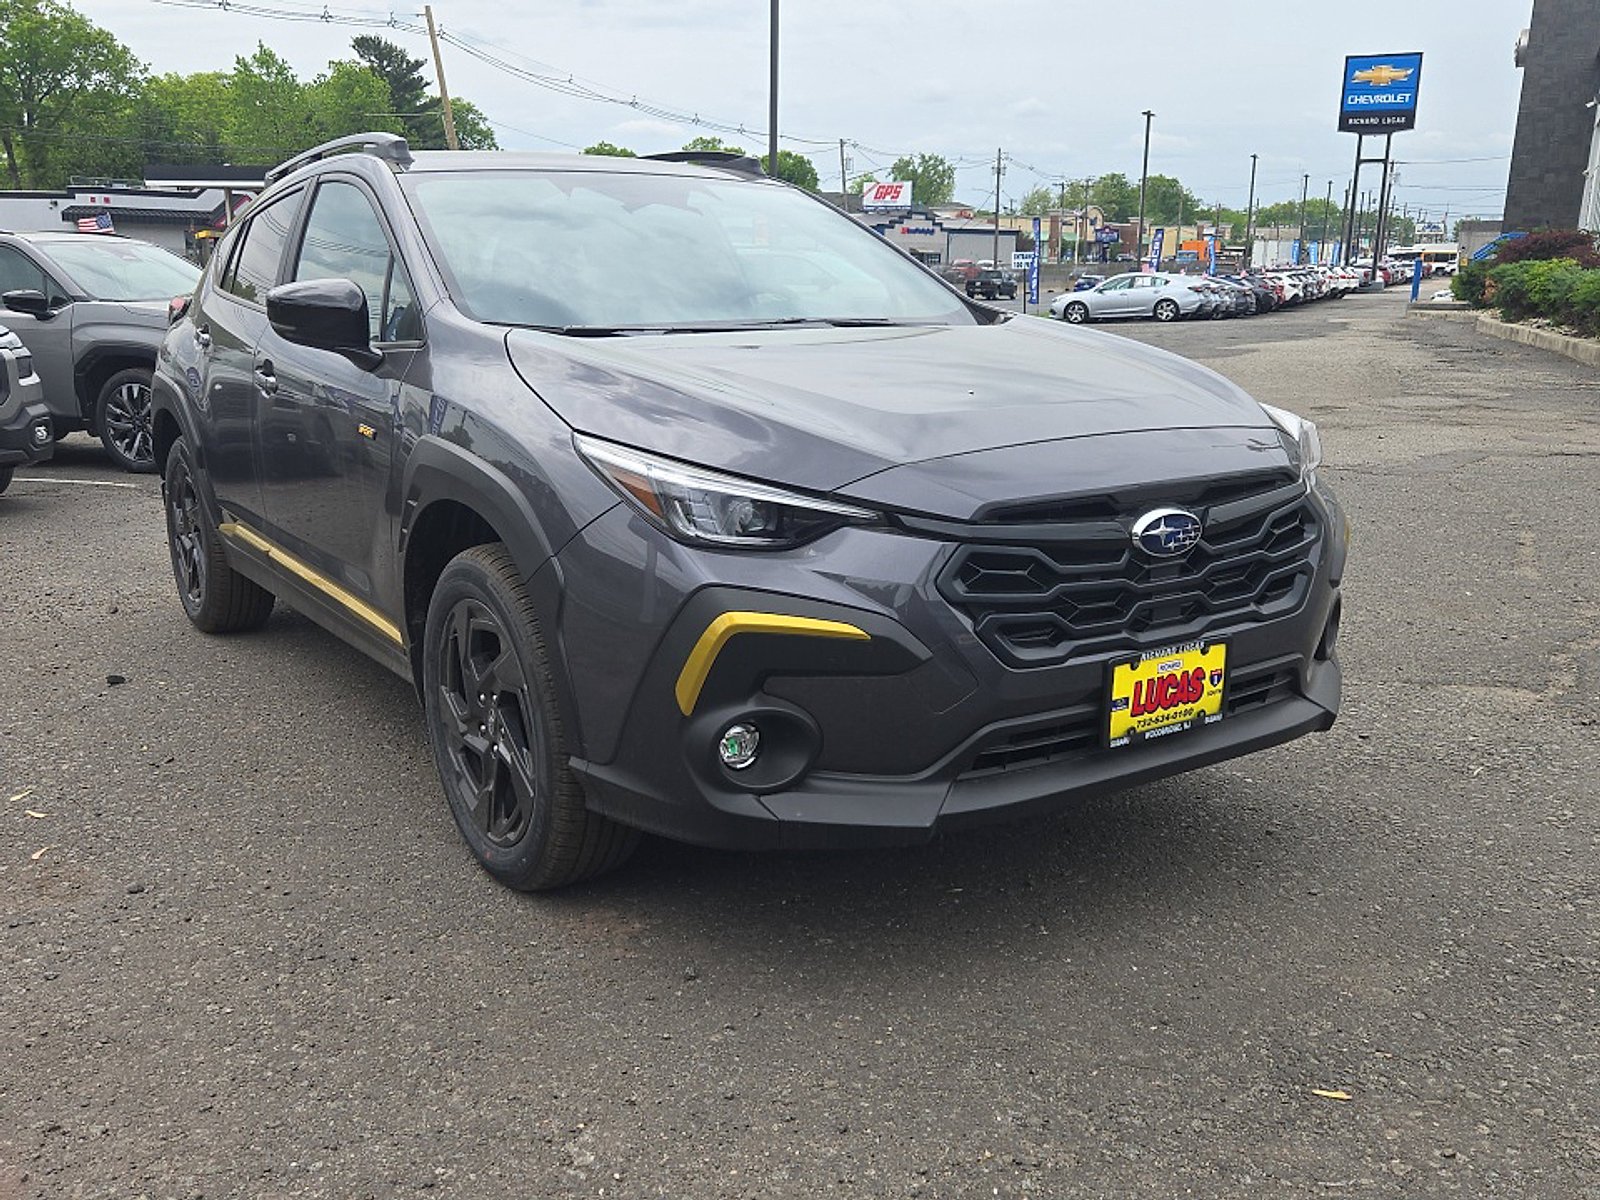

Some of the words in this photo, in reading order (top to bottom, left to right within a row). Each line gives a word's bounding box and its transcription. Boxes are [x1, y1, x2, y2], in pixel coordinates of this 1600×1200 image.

[1347, 93, 1411, 105] CHEVROLET
[874, 185, 904, 200] GPS
[1179, 641, 1205, 653] LUCAS
[1130, 667, 1206, 718] LUCAS
